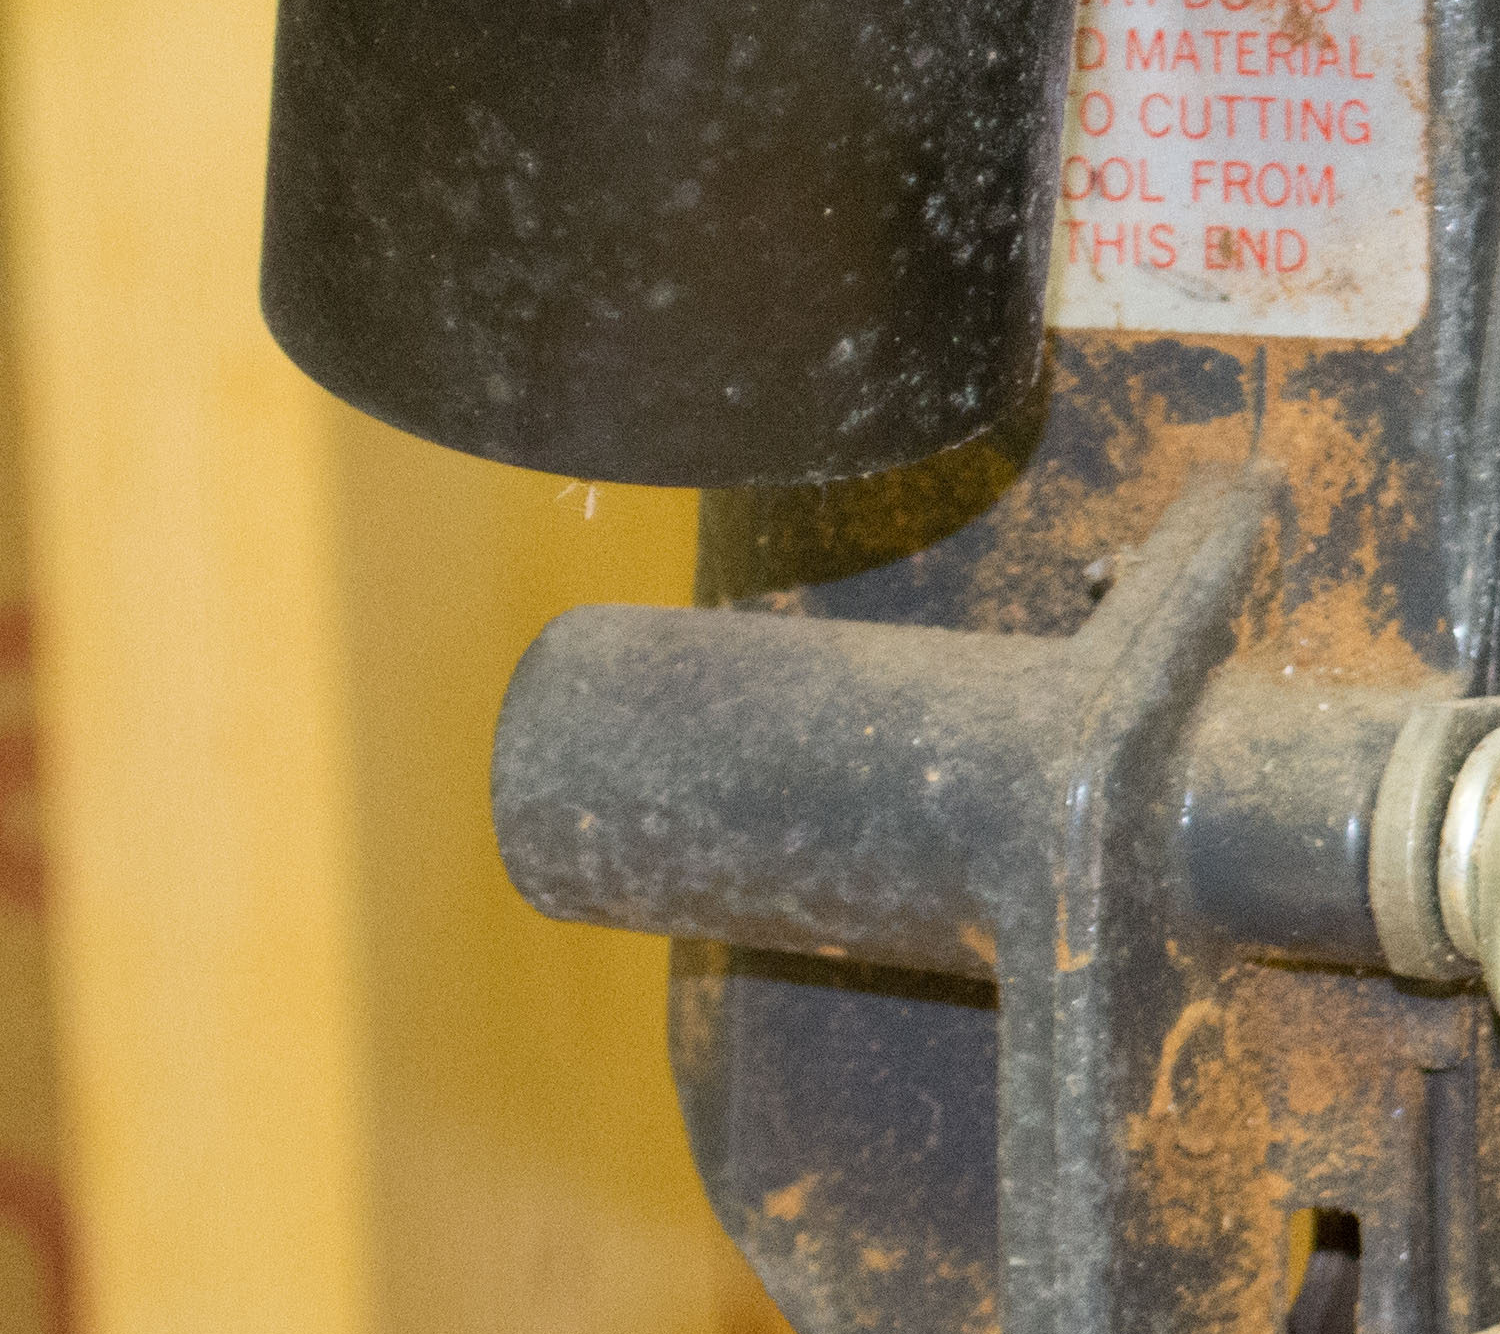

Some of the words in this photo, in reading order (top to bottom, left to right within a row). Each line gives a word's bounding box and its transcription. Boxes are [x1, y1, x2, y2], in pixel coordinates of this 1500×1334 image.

[1125, 28, 1375, 80] MATERIAL
[1138, 92, 1373, 146] CUTTING
[1190, 159, 1337, 209] FROM
[1060, 218, 1178, 269] THIS
[1204, 226, 1309, 275] END
